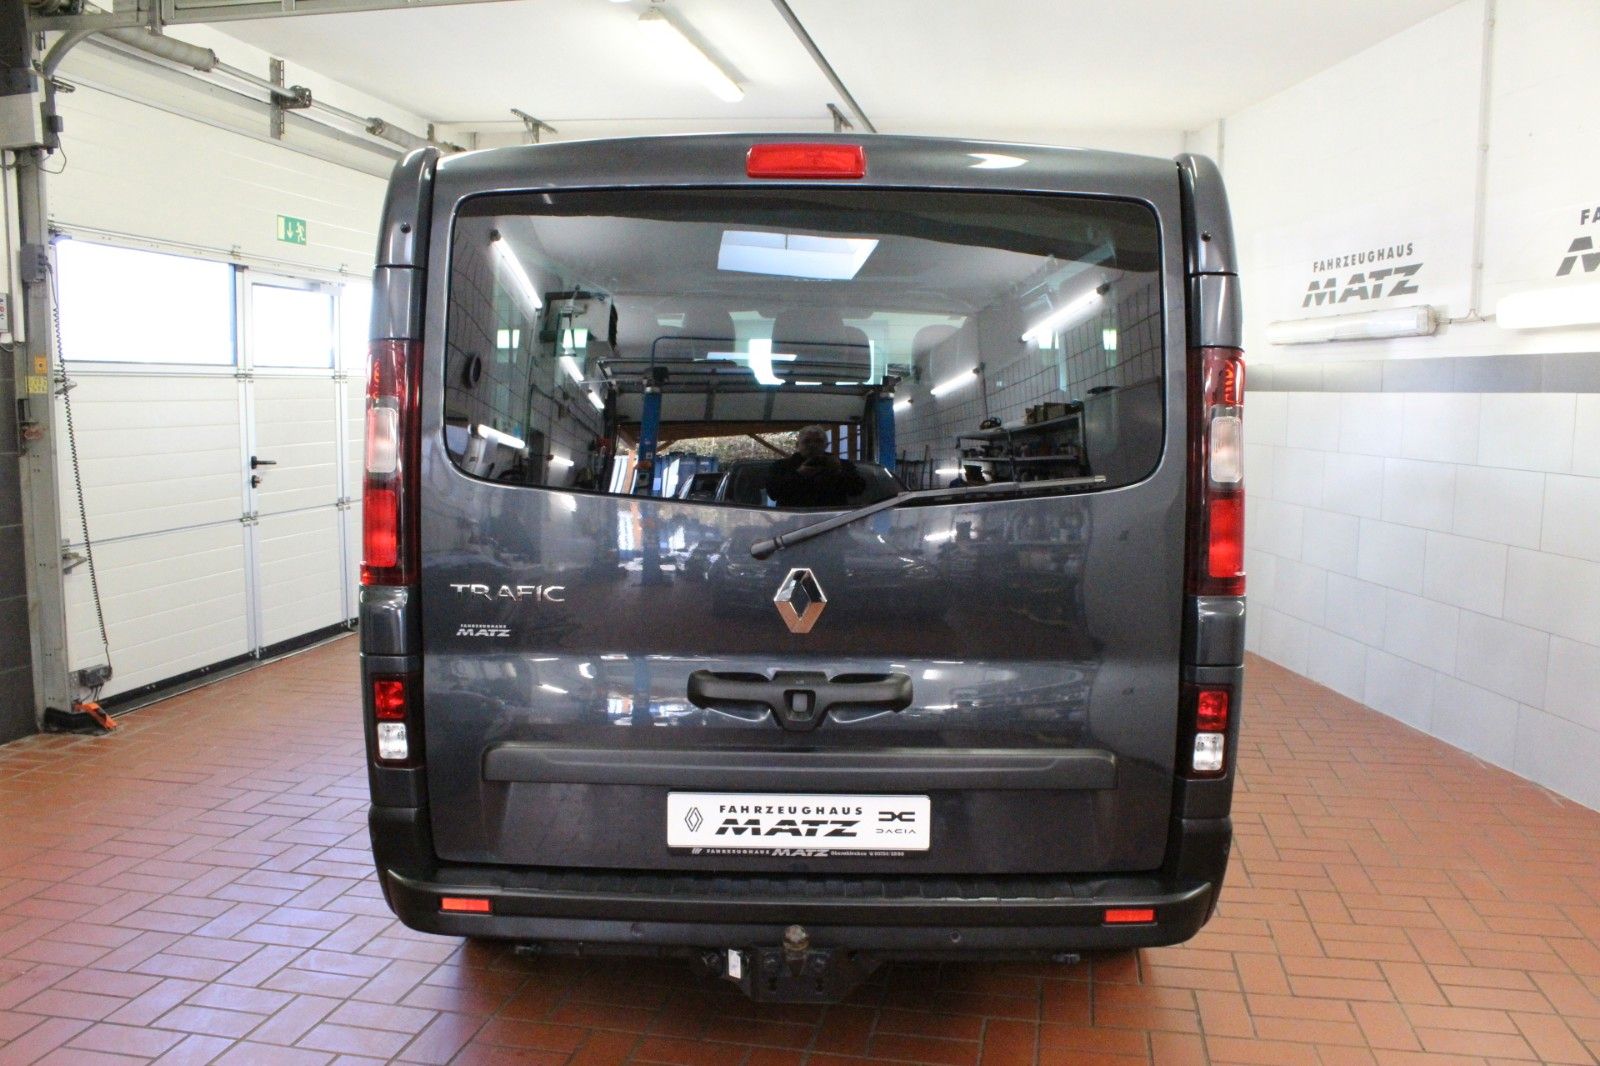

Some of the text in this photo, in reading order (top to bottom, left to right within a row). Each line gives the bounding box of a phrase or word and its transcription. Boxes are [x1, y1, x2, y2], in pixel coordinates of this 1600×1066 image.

[1313, 242, 1414, 273] FAHRZEUGHAUS
[1302, 262, 1424, 308] MATZ
[450, 584, 566, 602] TRAFIC
[456, 628, 511, 637] MATZ
[719, 805, 863, 816] FAHRZEUGHAUS
[714, 818, 861, 837] MATZ
[771, 847, 830, 857] MATZ
